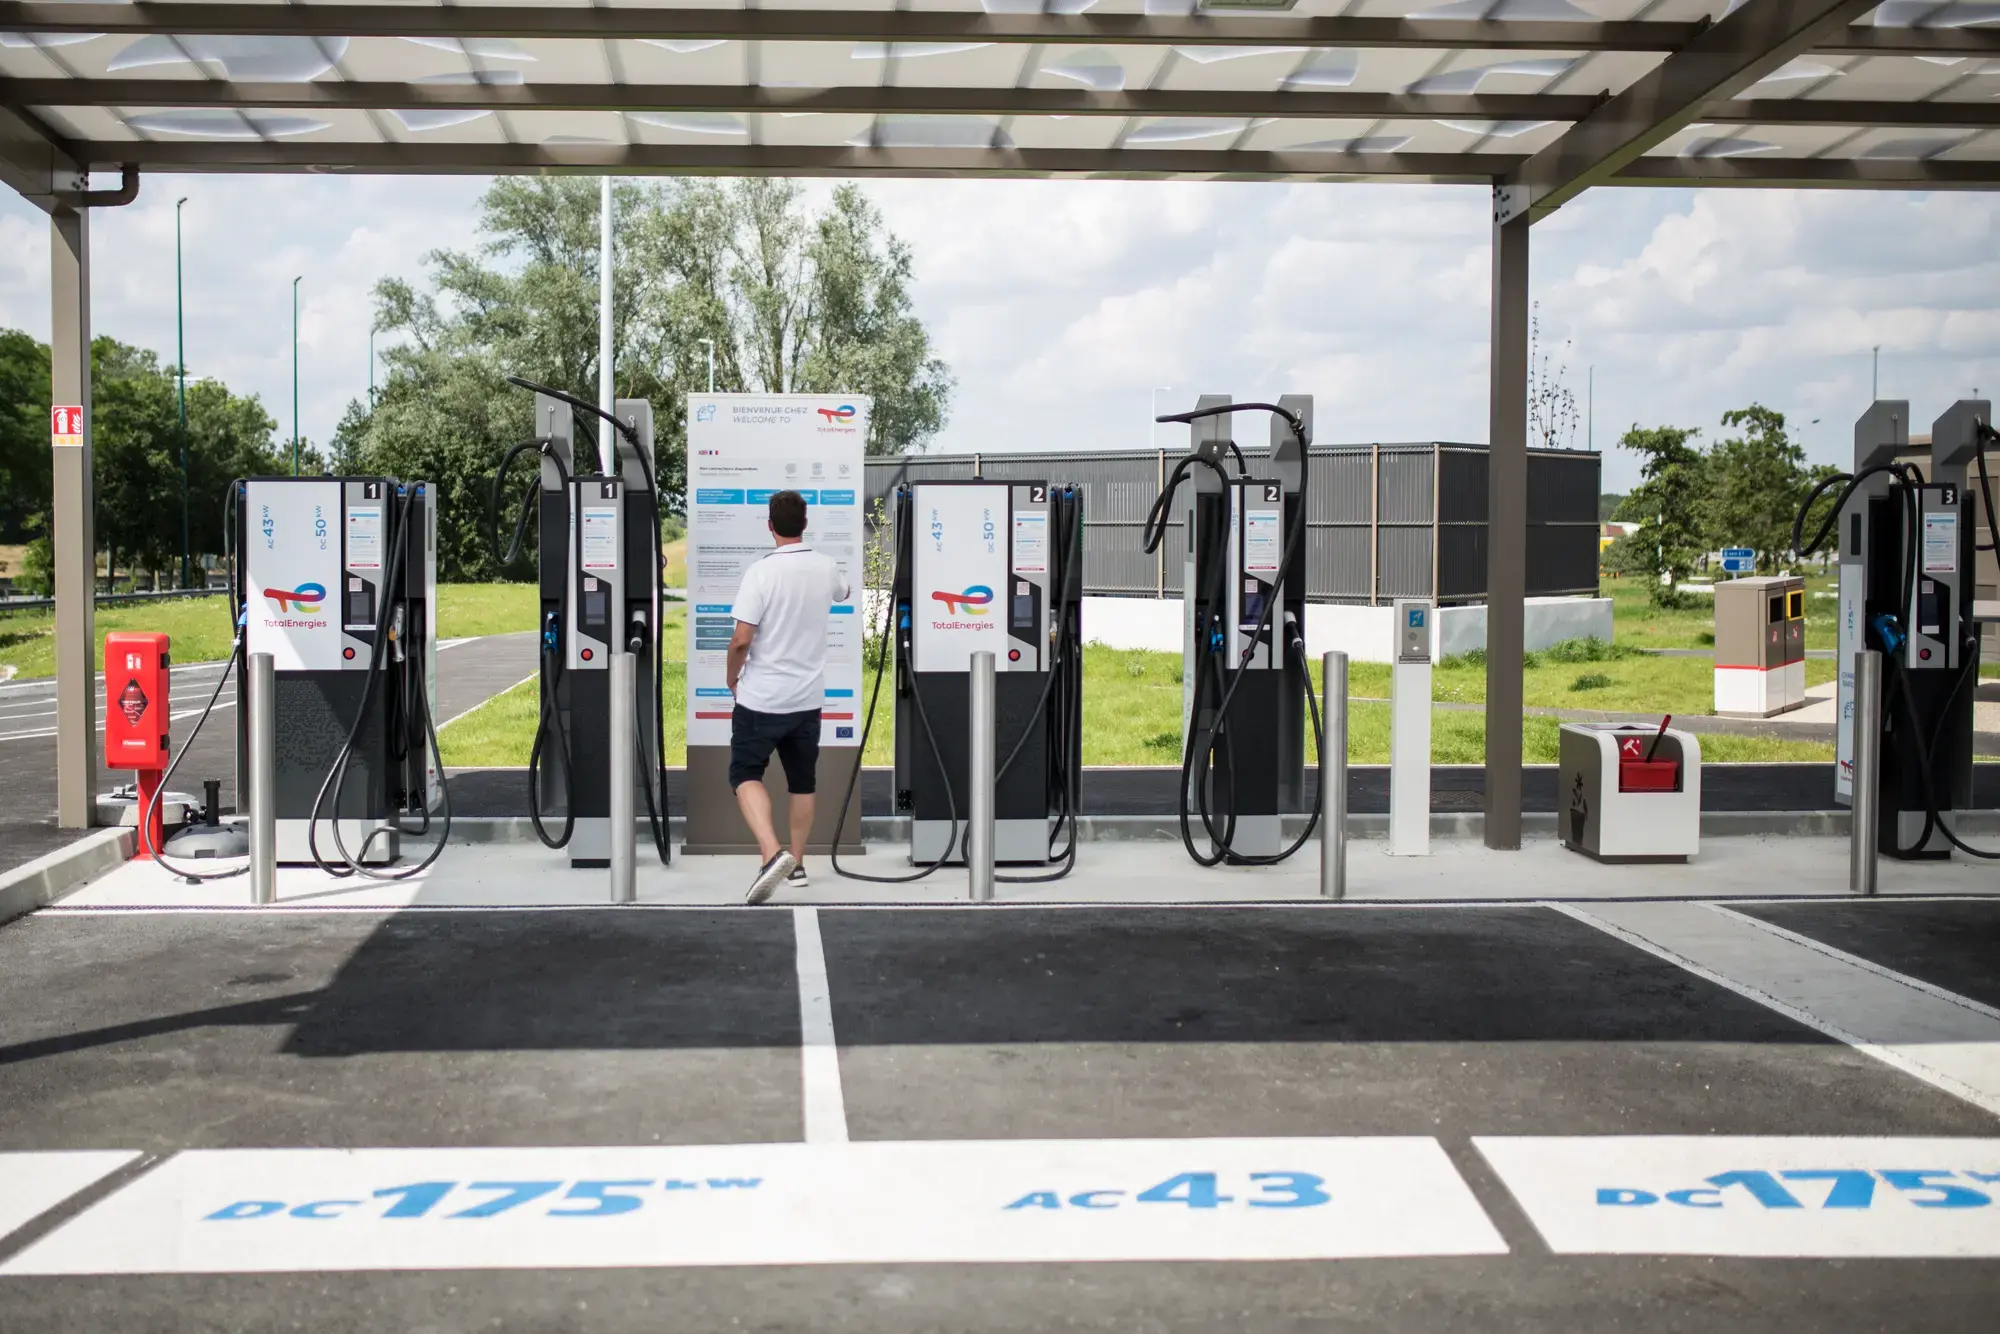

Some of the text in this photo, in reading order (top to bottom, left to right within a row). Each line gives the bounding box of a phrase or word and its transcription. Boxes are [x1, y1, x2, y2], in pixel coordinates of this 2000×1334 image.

[732, 406, 808, 414] BIENVENUE CHEZ
[733, 416, 791, 424] WELCOME TO
[368, 483, 377, 499] 1
[605, 483, 613, 498] 1
[1033, 487, 1044, 502] 2
[1267, 486, 1278, 501] 2
[1945, 490, 1953, 503] 3
[262, 504, 274, 550] AC 43 kW
[315, 504, 327, 550] DC 50 kW
[931, 522, 943, 540] 43
[983, 522, 994, 540] 50
[263, 619, 327, 629] TotalEnergies
[931, 621, 994, 631] TotalEnergies
[1001, 1171, 1332, 1209] AC 43
[201, 1200, 365, 1220] DC
[372, 1180, 654, 1219] 175
